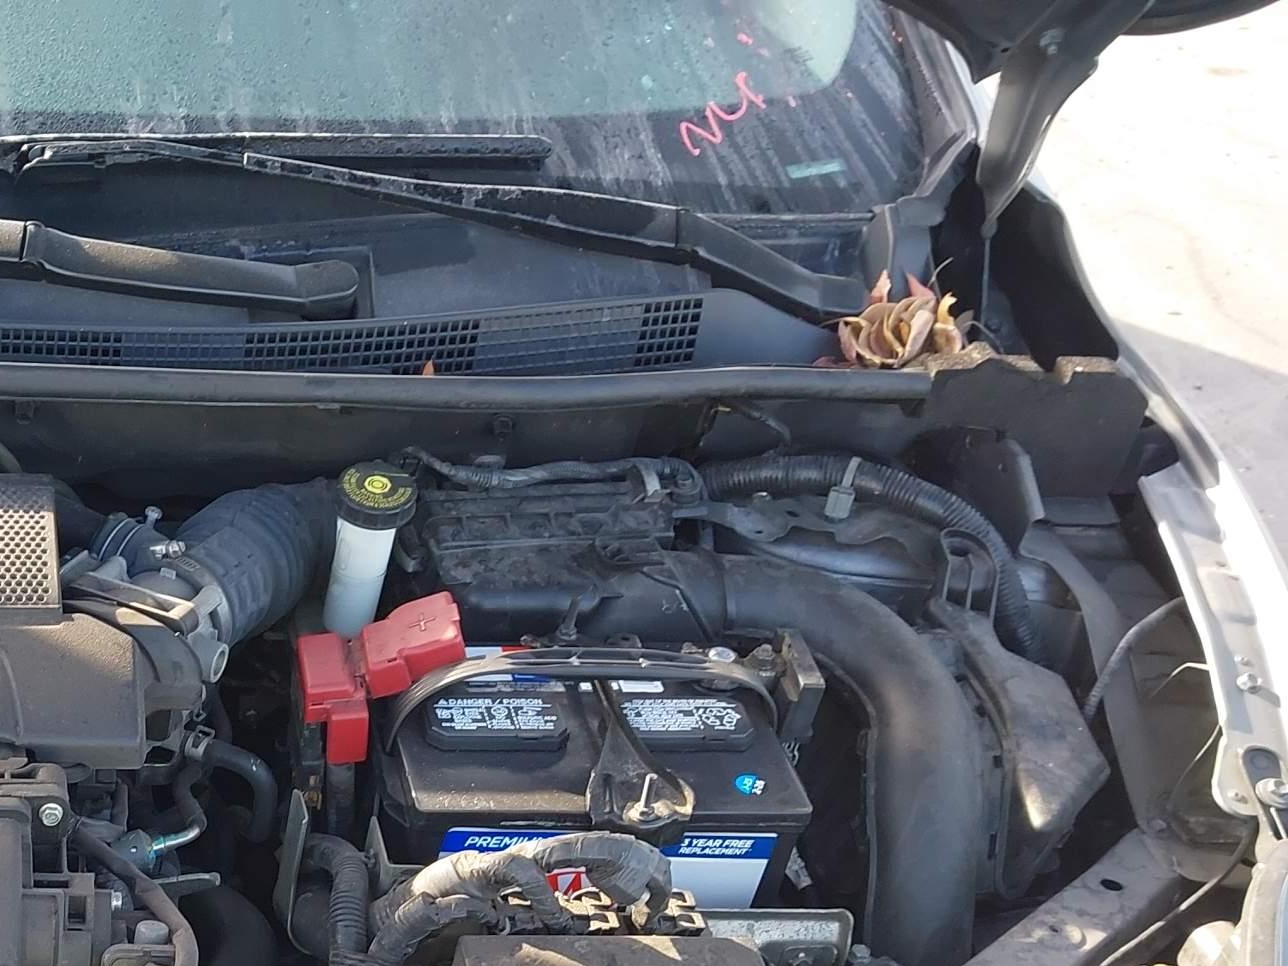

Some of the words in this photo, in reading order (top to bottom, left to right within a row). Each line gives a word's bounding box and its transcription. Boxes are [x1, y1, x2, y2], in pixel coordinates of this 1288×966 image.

[681, 838, 691, 847] 3
[692, 838, 723, 847] YEAR
[723, 839, 755, 848] FREE
